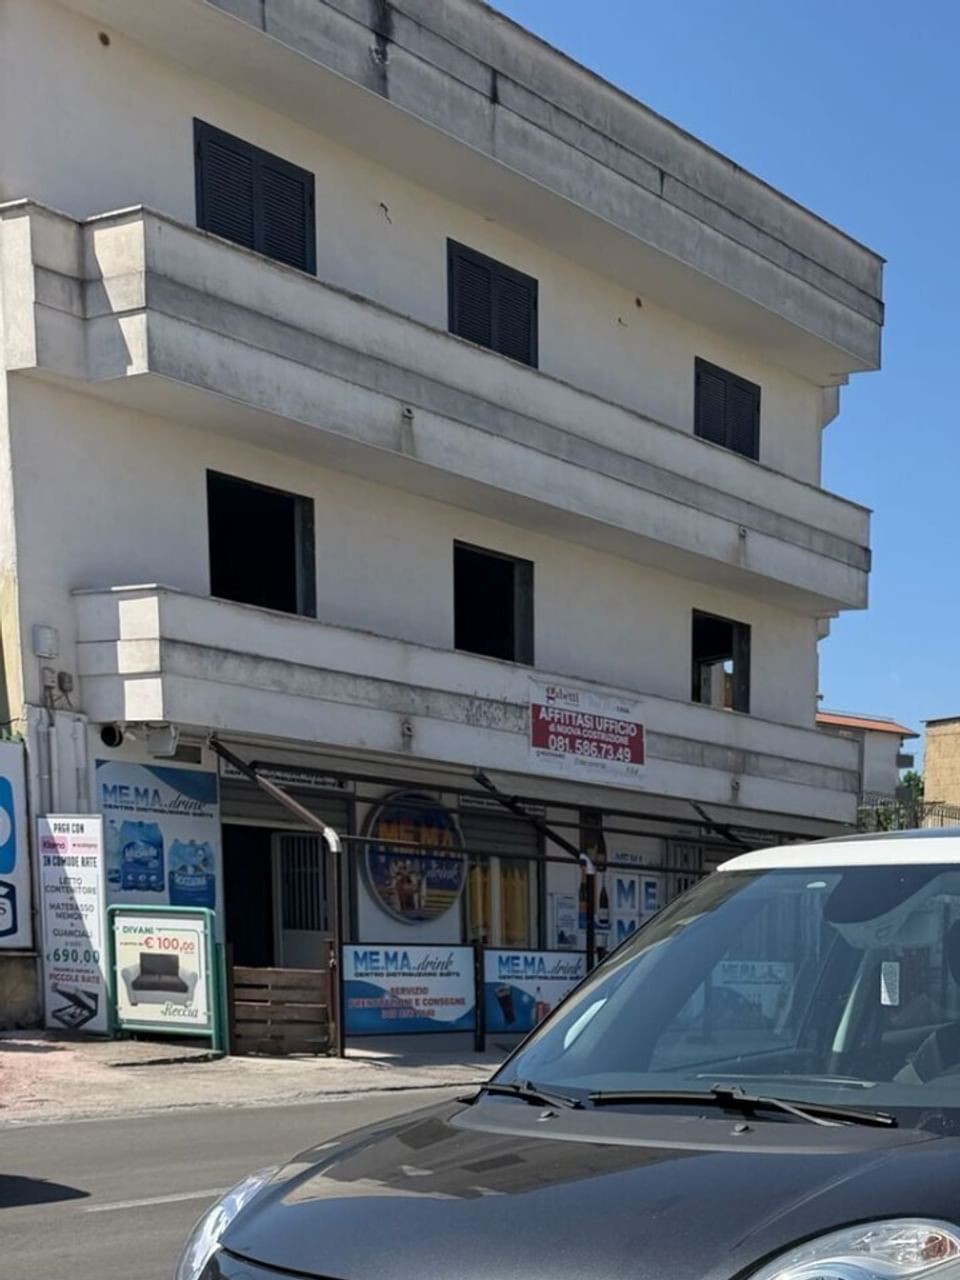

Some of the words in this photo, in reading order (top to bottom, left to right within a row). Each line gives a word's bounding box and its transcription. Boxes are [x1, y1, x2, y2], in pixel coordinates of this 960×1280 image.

[539, 706, 594, 729] AFFITTASI
[595, 717, 637, 737] UFFICIO
[556, 724, 581, 736] NUOVA
[583, 729, 630, 746] COSTRUZIONE
[71, 824, 84, 834] CON
[59, 876, 83, 885] LETTO
[44, 885, 97, 895] CONTENITORE
[49, 903, 95, 912] MATERASSO
[55, 912, 88, 921] MEMORY
[122, 926, 154, 934] DIVANI
[49, 973, 79, 982] PICCOLE
[81, 974, 100, 984] RATE
[390, 986, 429, 995] SERVIZIO
[422, 998, 465, 1007] CONSEGNE
